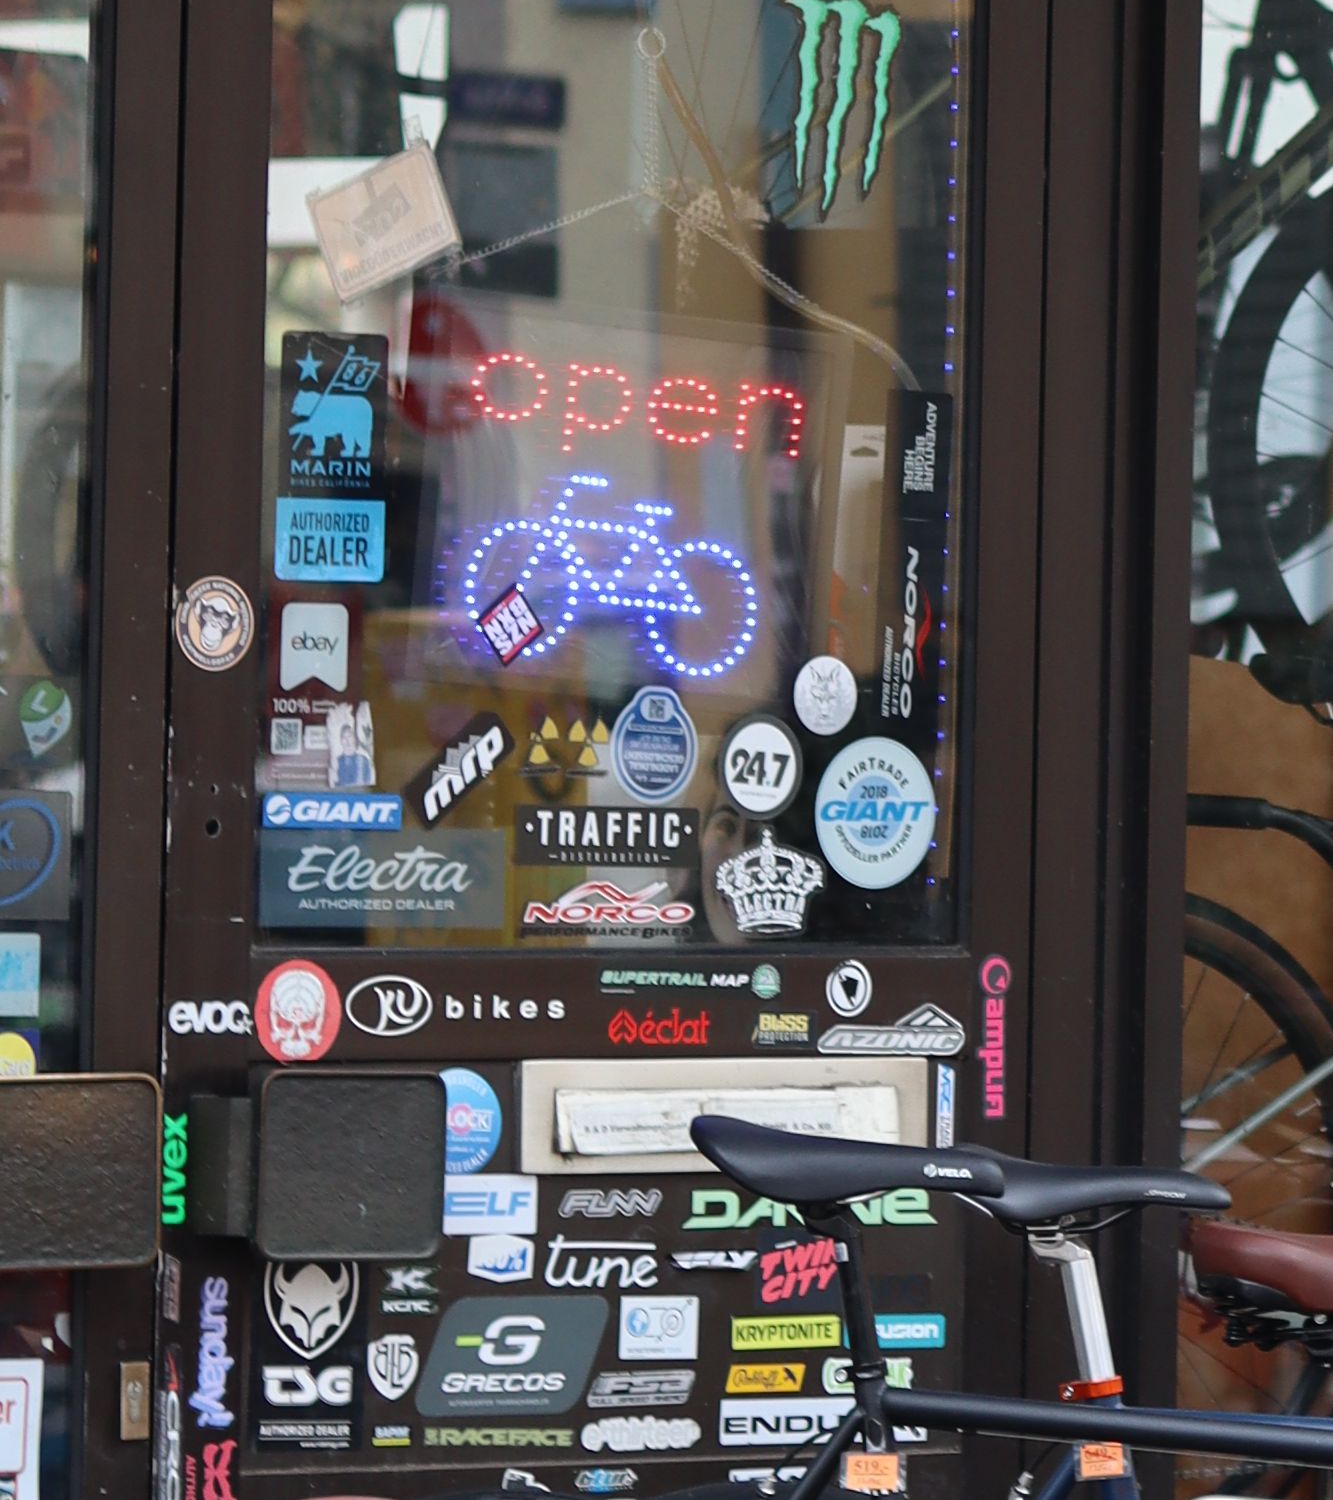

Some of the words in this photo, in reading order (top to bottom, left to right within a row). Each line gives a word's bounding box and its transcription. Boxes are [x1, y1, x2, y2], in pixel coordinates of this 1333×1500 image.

[471, 350, 804, 455] open
[914, 435, 926, 492] BEGINS
[922, 401, 938, 493] ADVENTURE
[290, 458, 371, 477] MARIN
[902, 449, 915, 495] HERE.
[289, 511, 370, 533] AUTHORIZED
[288, 535, 369, 568] DEALER
[290, 631, 339, 657] ebay
[899, 546, 919, 719] NORCO
[882, 625, 894, 680] AUTHORIZED
[881, 681, 891, 717] DEALER
[891, 652, 901, 716] BICYCLES
[272, 697, 311, 714] 100%
[422, 725, 505, 822] mrp
[838, 757, 910, 791] FAIRTRADE
[859, 784, 889, 798] 2018
[292, 802, 399, 824] GIANT
[820, 800, 930, 823] GIANT
[536, 810, 681, 848] TRAFFIC
[287, 844, 474, 893] Electra
[560, 852, 659, 864] DISTRIBUTION
[298, 897, 393, 911] AUTHORIZED
[395, 897, 455, 911] DEALER
[523, 901, 695, 924] NORCO
[519, 925, 641, 939] PERFORMANCE
[641, 925, 693, 940] BIKES
[600, 970, 708, 987] SUPERTRAIL
[709, 971, 750, 988] MAP
[445, 994, 567, 1020] bikes
[638, 1006, 711, 1045] éclat
[822, 1030, 960, 1049] AZONIC
[160, 1112, 189, 1225] uvex
[544, 1233, 658, 1288] tune
[761, 1263, 838, 1303] CITY
[735, 1321, 833, 1343] KRYPTONITE
[188, 1275, 235, 1430] sunday!
[440, 1372, 567, 1394] GRECOS
[258, 1424, 314, 1437] AUTHORIZED
[315, 1423, 350, 1436] DEALER
